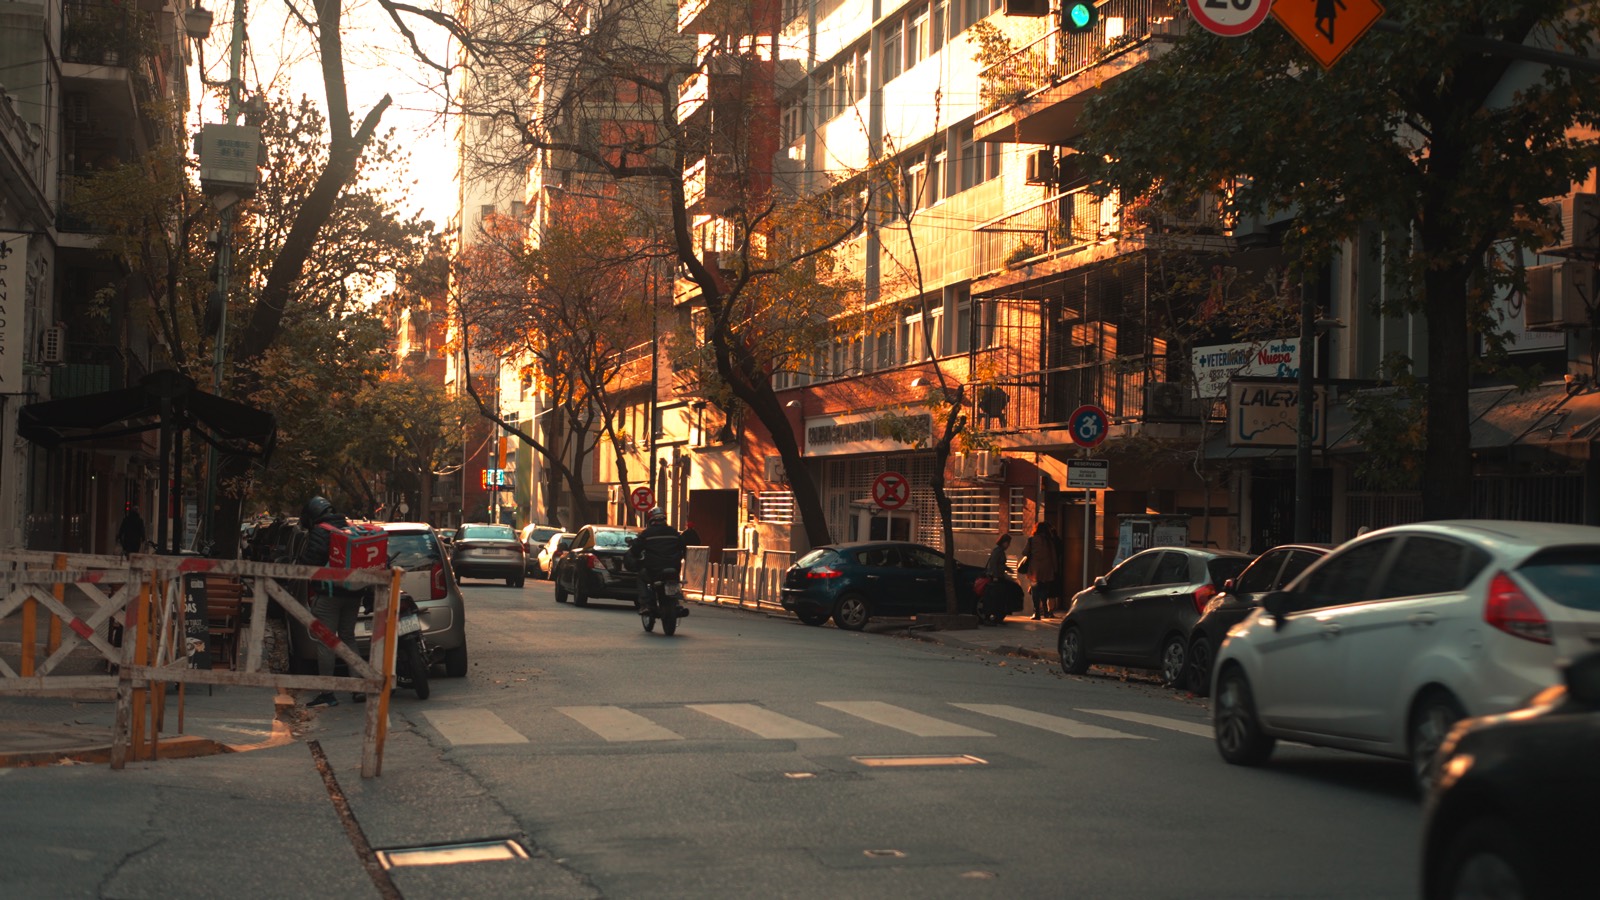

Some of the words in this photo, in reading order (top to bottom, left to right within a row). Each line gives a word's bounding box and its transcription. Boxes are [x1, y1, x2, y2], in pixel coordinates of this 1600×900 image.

[1270, 345, 1280, 353] Pet
[1281, 344, 1296, 353] Shop
[1258, 349, 1292, 365] Nueva
